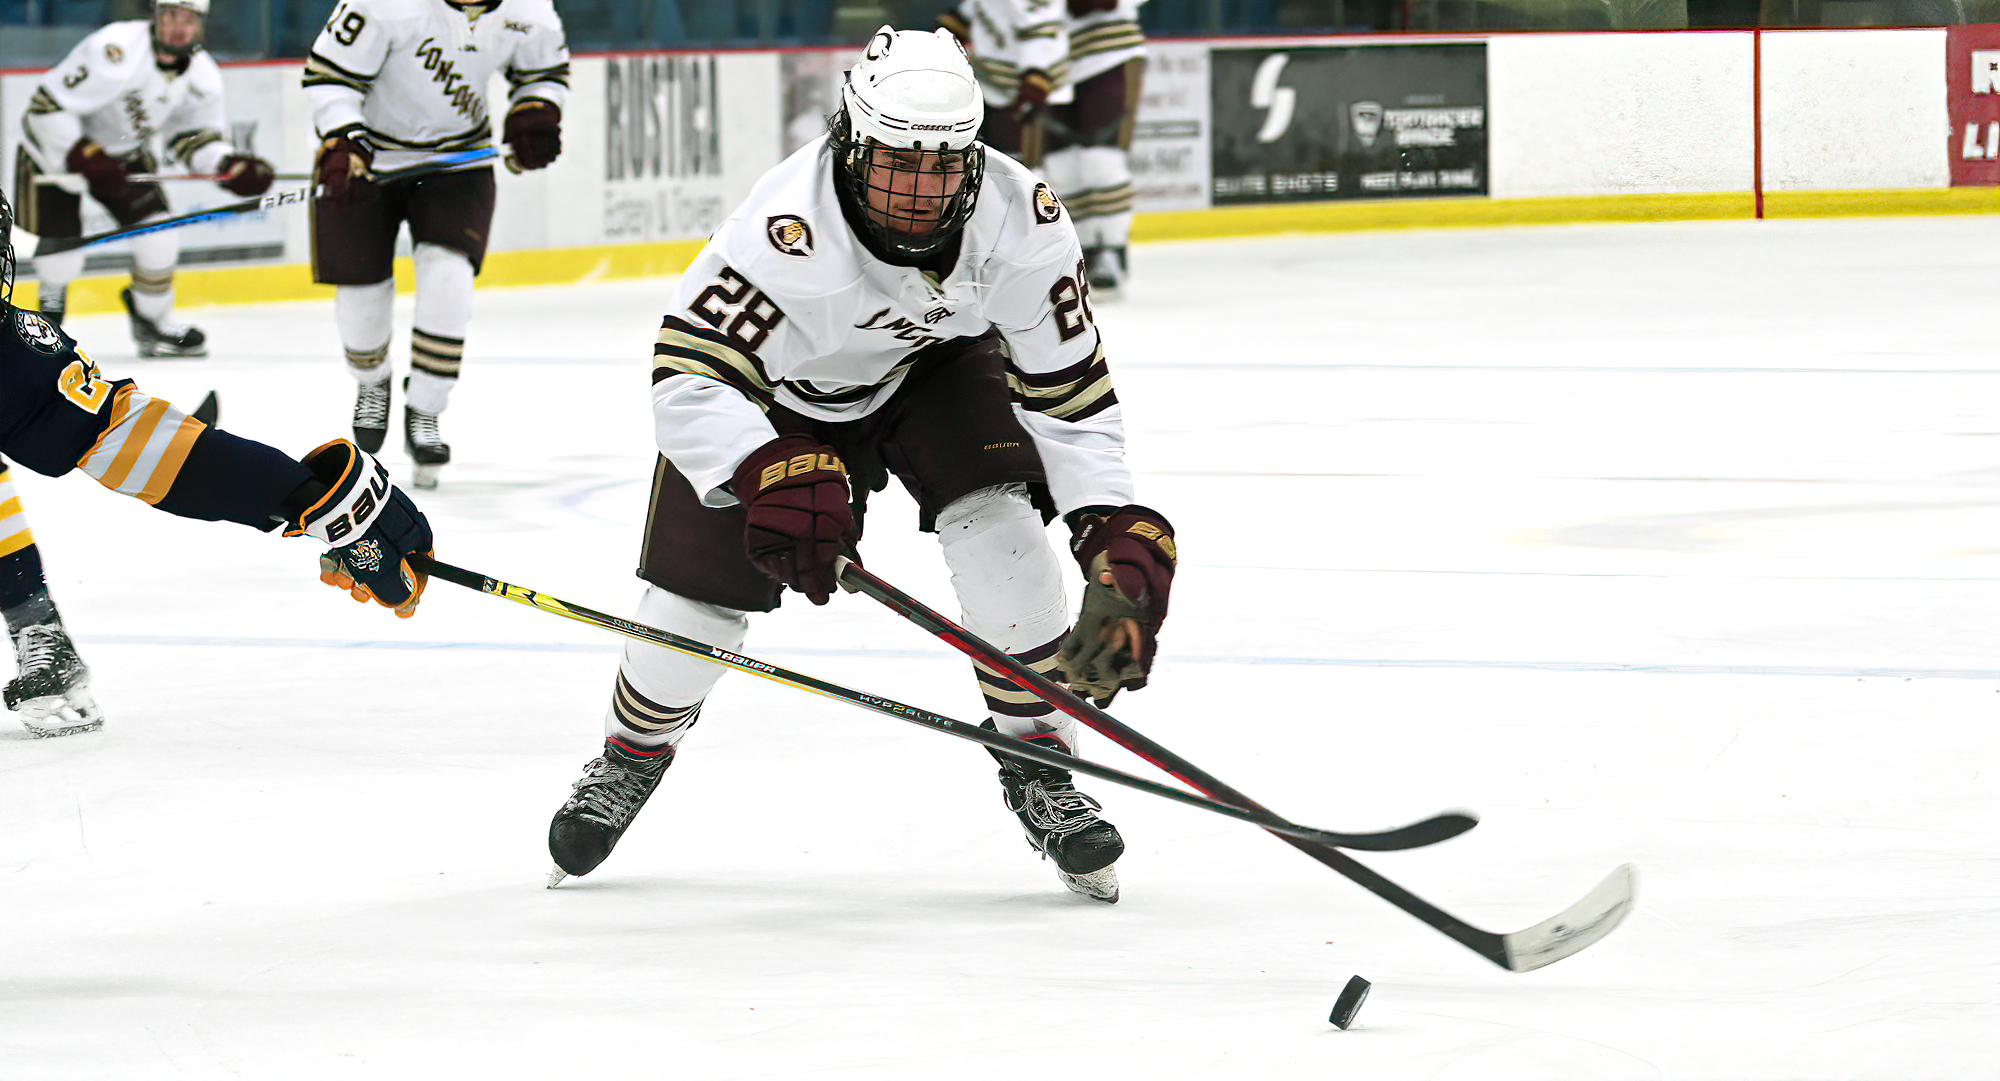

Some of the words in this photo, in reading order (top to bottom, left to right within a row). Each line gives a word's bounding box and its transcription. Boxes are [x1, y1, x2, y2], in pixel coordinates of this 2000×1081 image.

[63, 65, 88, 89] 3
[688, 266, 785, 353] 28
[721, 652, 776, 674] BAUER
